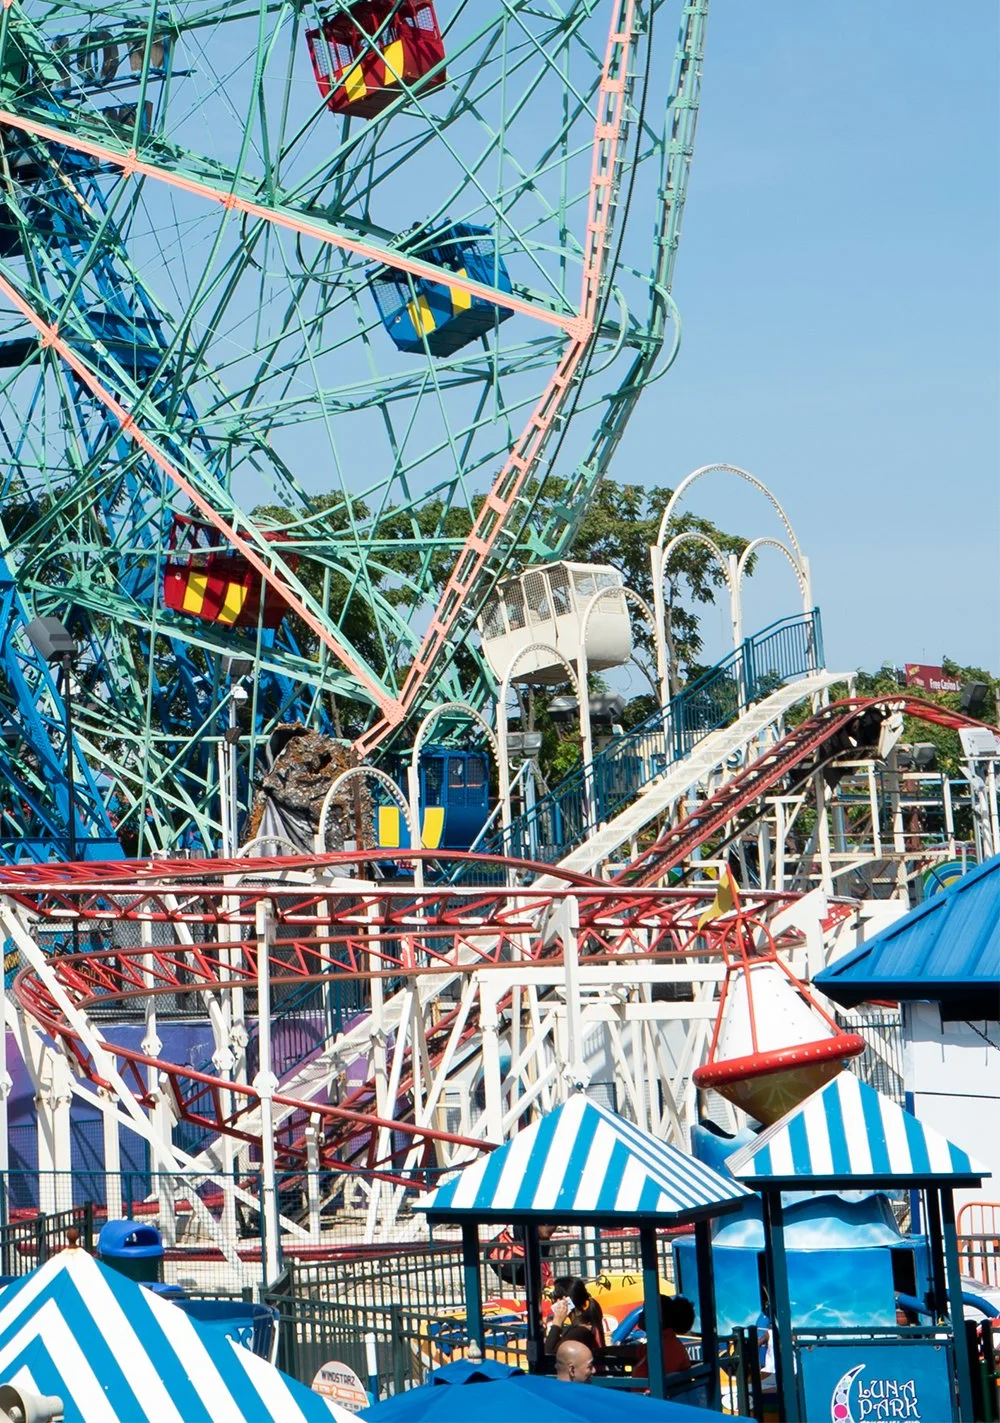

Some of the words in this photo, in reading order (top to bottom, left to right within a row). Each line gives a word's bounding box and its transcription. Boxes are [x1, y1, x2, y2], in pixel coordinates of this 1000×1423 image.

[685, 1346, 701, 1361] XIT
[858, 1380, 915, 1398] LUNA
[858, 1397, 921, 1421] PARK
